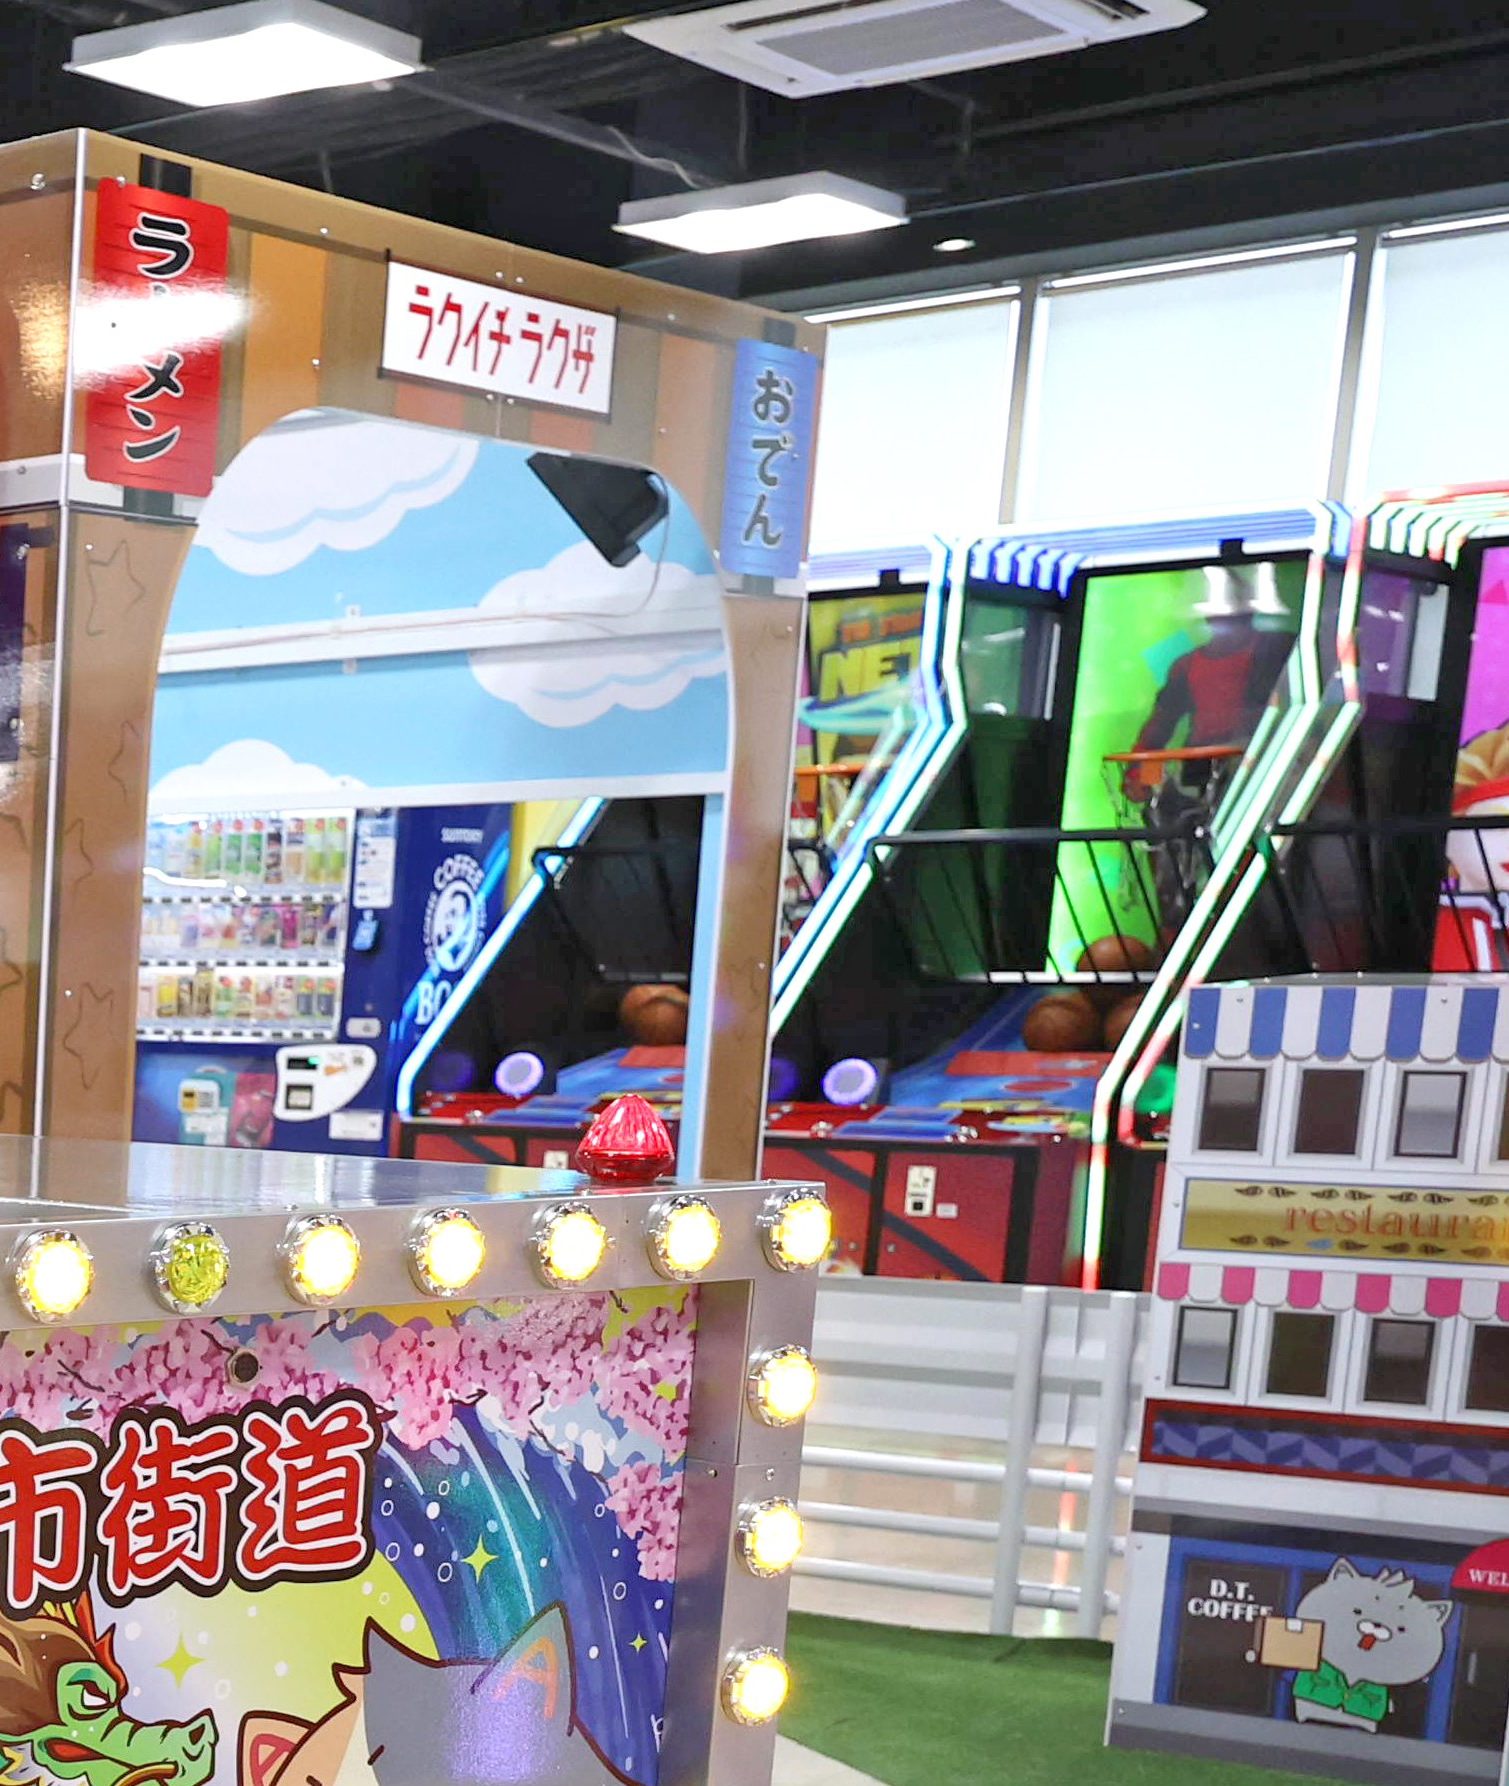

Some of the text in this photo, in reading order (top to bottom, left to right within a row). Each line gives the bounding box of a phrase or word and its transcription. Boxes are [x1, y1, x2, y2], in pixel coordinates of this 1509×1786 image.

[123, 211, 194, 462] ラメン
[740, 367, 795, 549] おでん
[1286, 1203, 1509, 1241] restaura
[1210, 1578, 1255, 1601] D.T.
